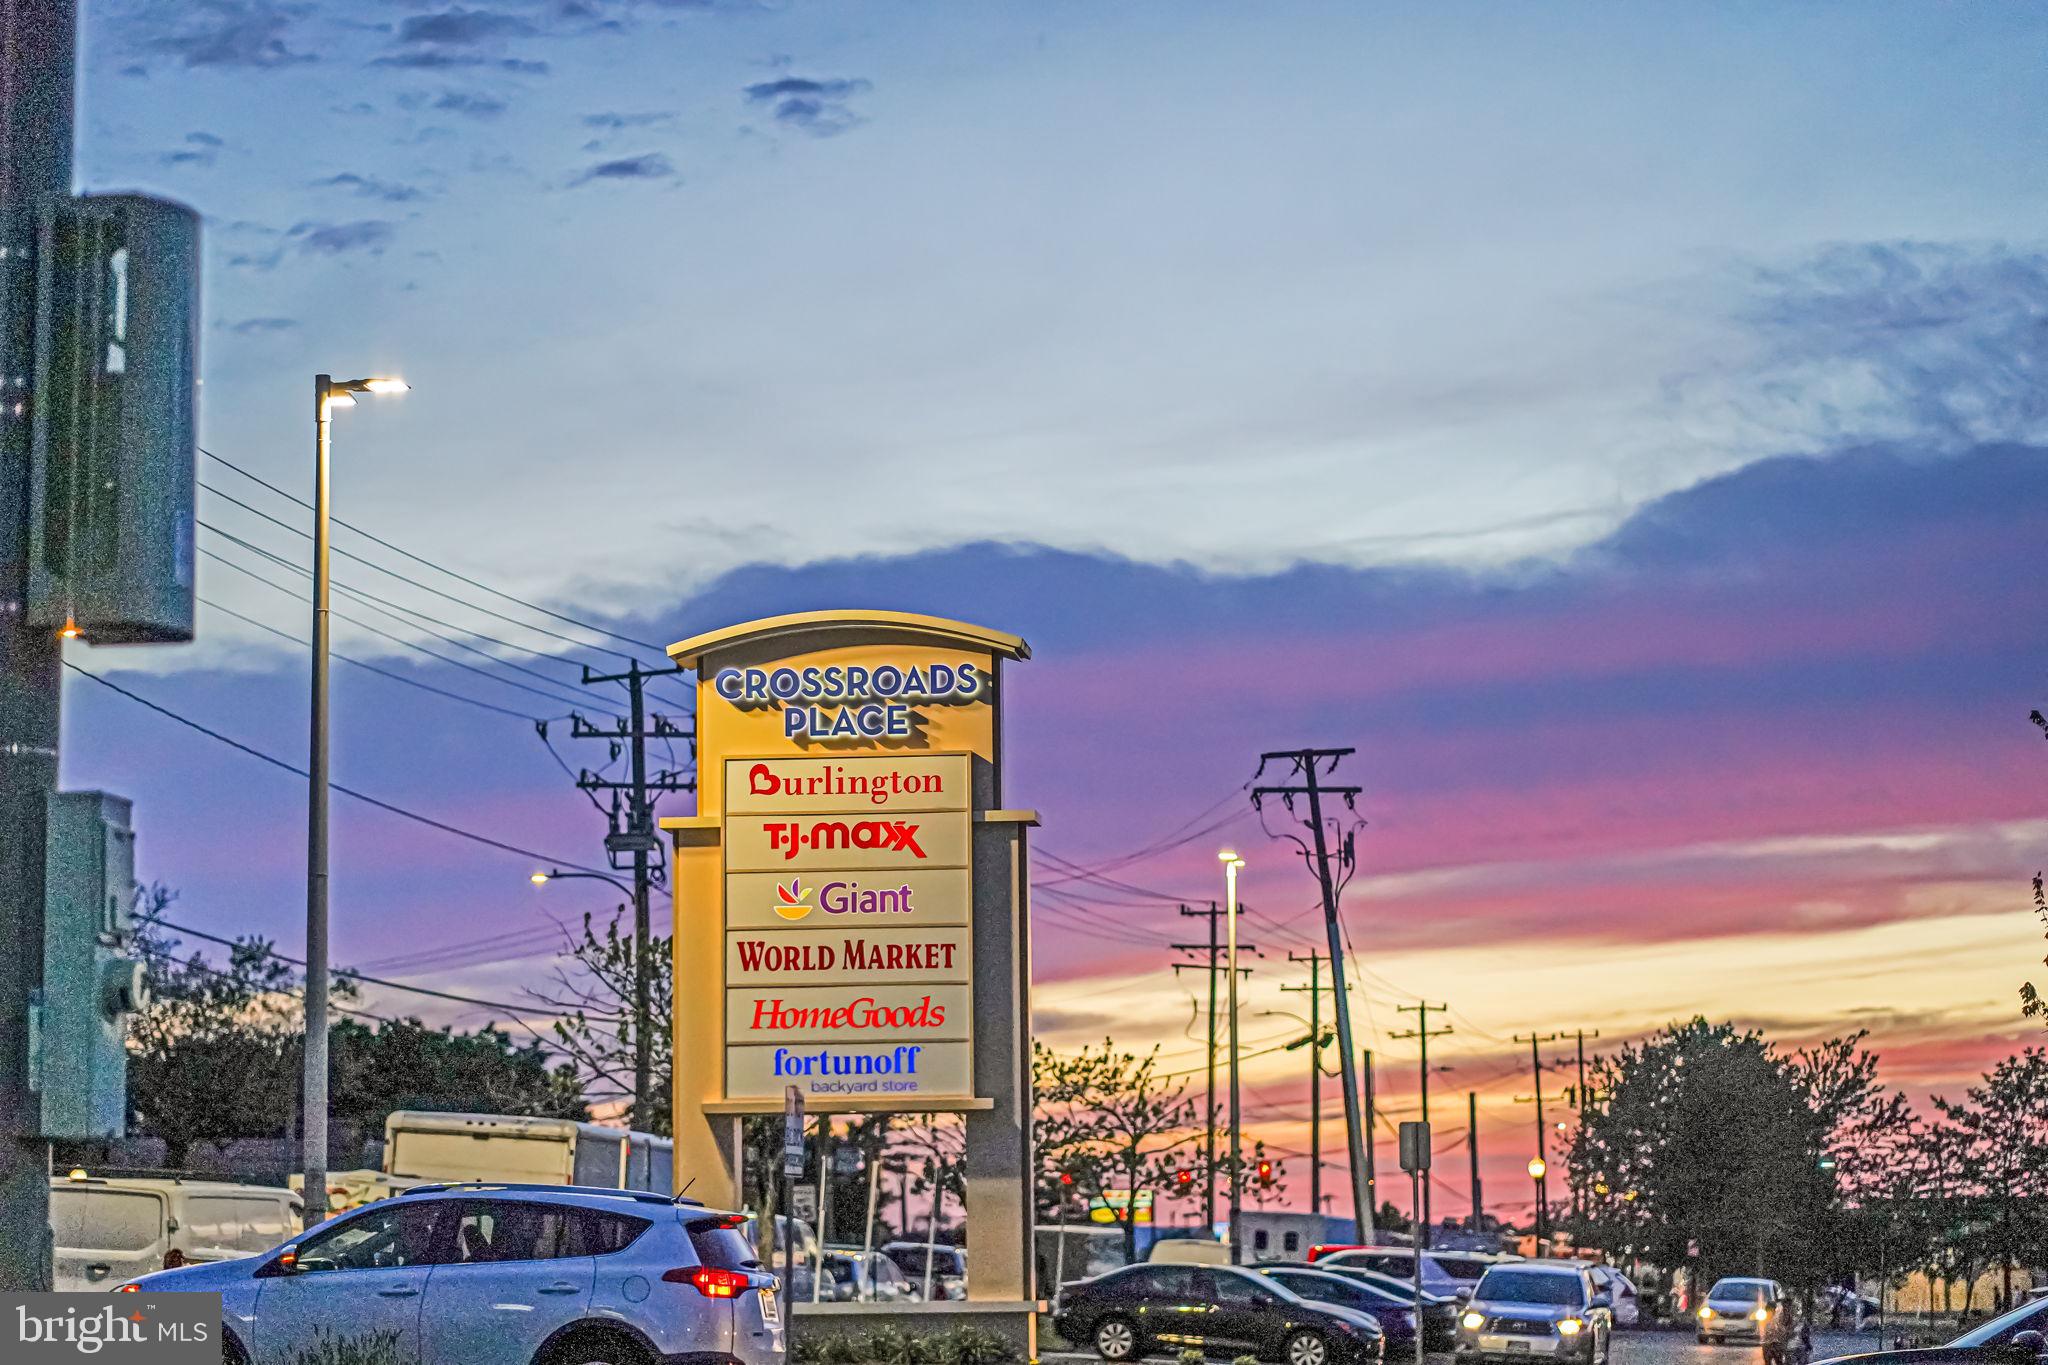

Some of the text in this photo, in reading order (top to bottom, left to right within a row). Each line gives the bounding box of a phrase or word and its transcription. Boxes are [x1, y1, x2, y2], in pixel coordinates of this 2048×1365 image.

[715, 663, 978, 699] CROSSROADS
[785, 705, 908, 738] PLACE
[749, 763, 944, 804] Burlington
[819, 881, 914, 914] Giant
[736, 939, 957, 972] WORLD MARKET
[750, 995, 946, 1031] HomeGoods
[773, 1045, 923, 1077] fortunoff
[811, 1079, 919, 1095] backyard store
